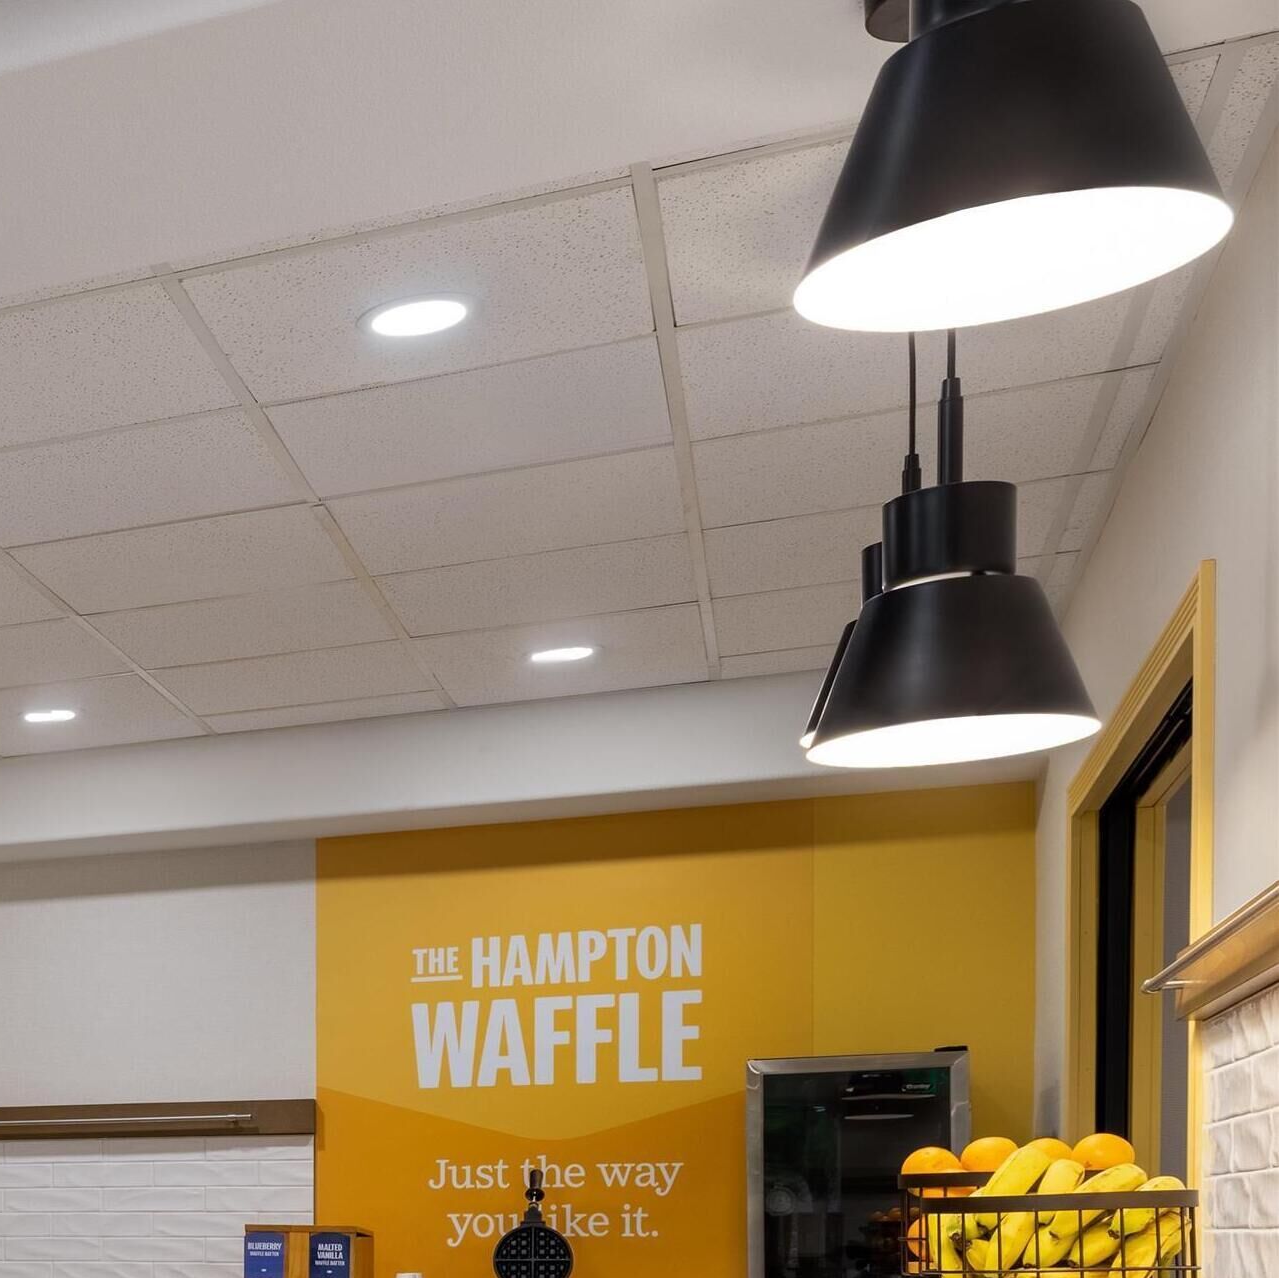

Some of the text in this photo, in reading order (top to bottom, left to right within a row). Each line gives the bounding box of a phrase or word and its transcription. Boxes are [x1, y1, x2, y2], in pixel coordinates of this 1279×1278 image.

[412, 923, 703, 988] THE HAMPTON
[410, 989, 703, 1089] WAFFLE
[428, 1155, 685, 1197] Just the way
[247, 1241, 283, 1251] BLUEBERRY
[446, 1203, 659, 1248] you ike it.
[317, 1243, 343, 1251] MALTED
[317, 1251, 344, 1260] VANILLA
